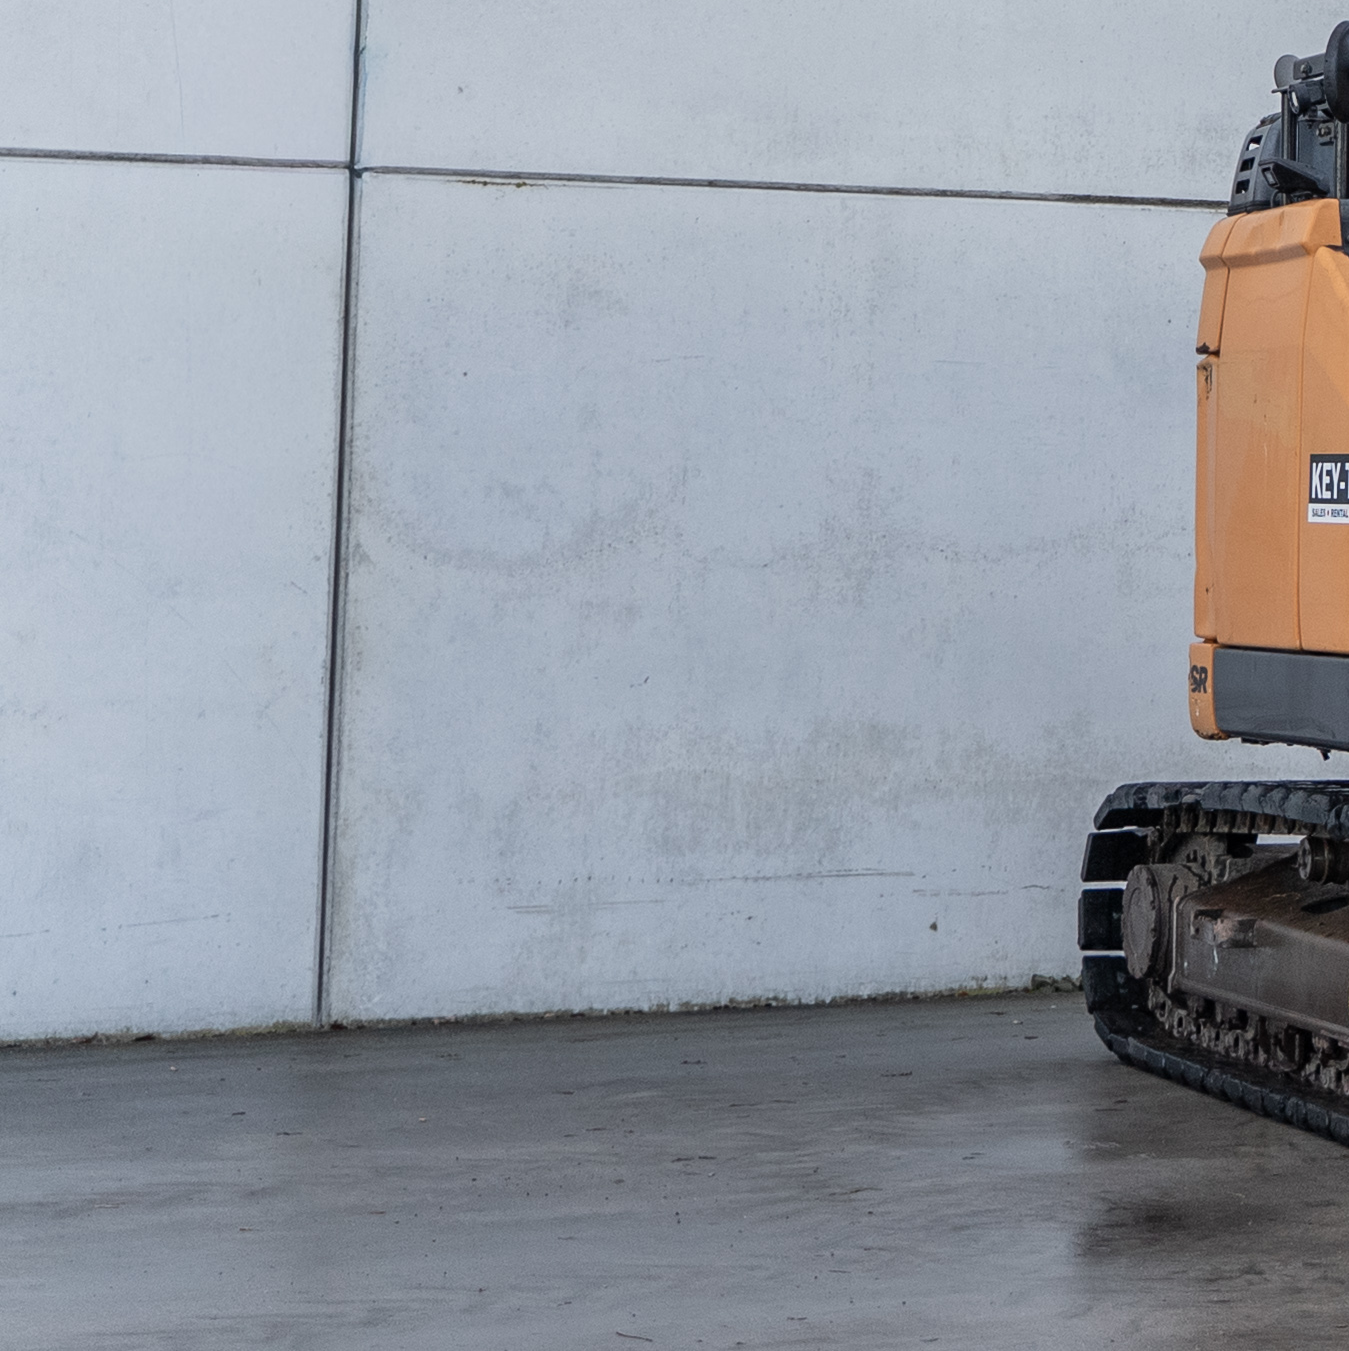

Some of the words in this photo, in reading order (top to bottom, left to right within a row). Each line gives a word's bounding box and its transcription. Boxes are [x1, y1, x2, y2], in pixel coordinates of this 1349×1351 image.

[1311, 508, 1326, 518] SALES
[1330, 508, 1349, 519] RENTAL
[1190, 664, 1208, 694] SR
